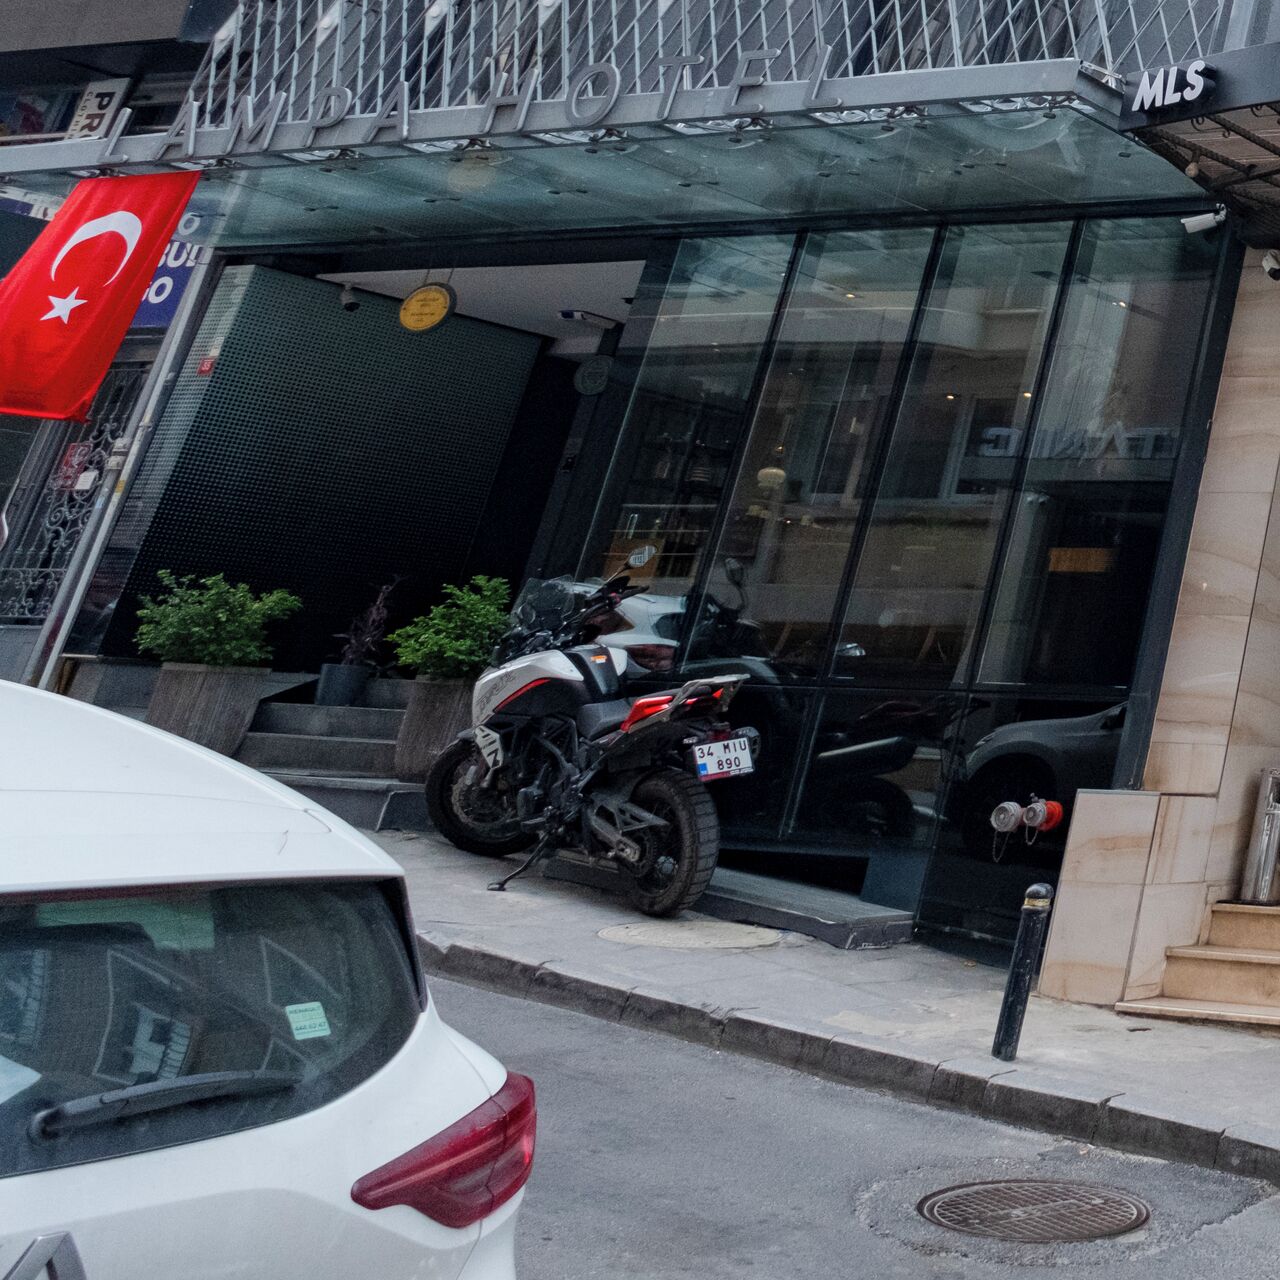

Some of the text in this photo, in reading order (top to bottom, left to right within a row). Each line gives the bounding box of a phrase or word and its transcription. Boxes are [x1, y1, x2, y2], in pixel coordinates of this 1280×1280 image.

[97, 44, 844, 166] LAMPA HOTEL
[1131, 60, 1207, 112] MLS
[79, 91, 117, 138] PR
[697, 740, 747, 759] 34 MIU
[717, 757, 741, 770] 890
